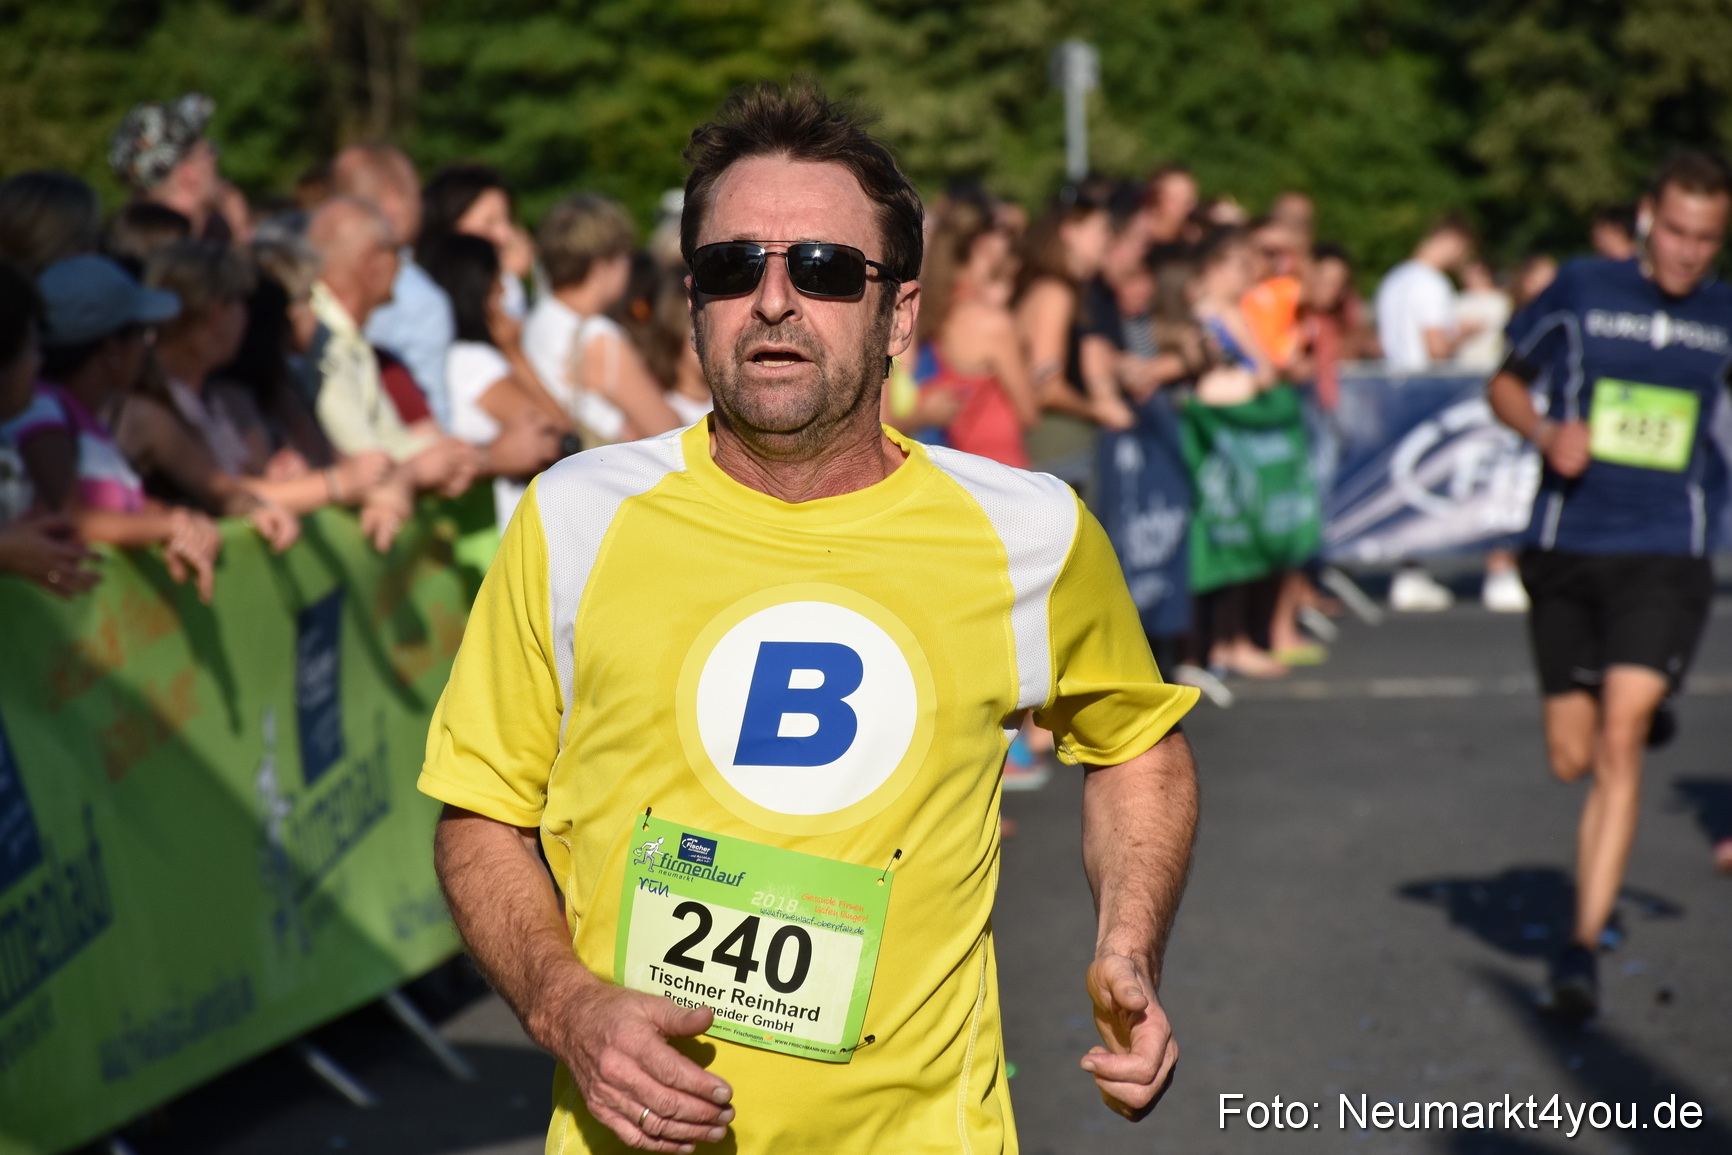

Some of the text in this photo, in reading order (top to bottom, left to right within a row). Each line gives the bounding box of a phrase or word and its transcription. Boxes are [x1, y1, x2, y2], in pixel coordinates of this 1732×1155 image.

[732, 640, 865, 768] B
[658, 853, 746, 887] firmenlauf
[658, 869, 695, 883] neumarkt
[751, 891, 799, 913] 2018
[662, 901, 813, 994] 240
[649, 965, 821, 1022] Tischner Reinhard
[733, 1028, 764, 1041] Frischmann
[752, 1014, 794, 1033] GmbH
